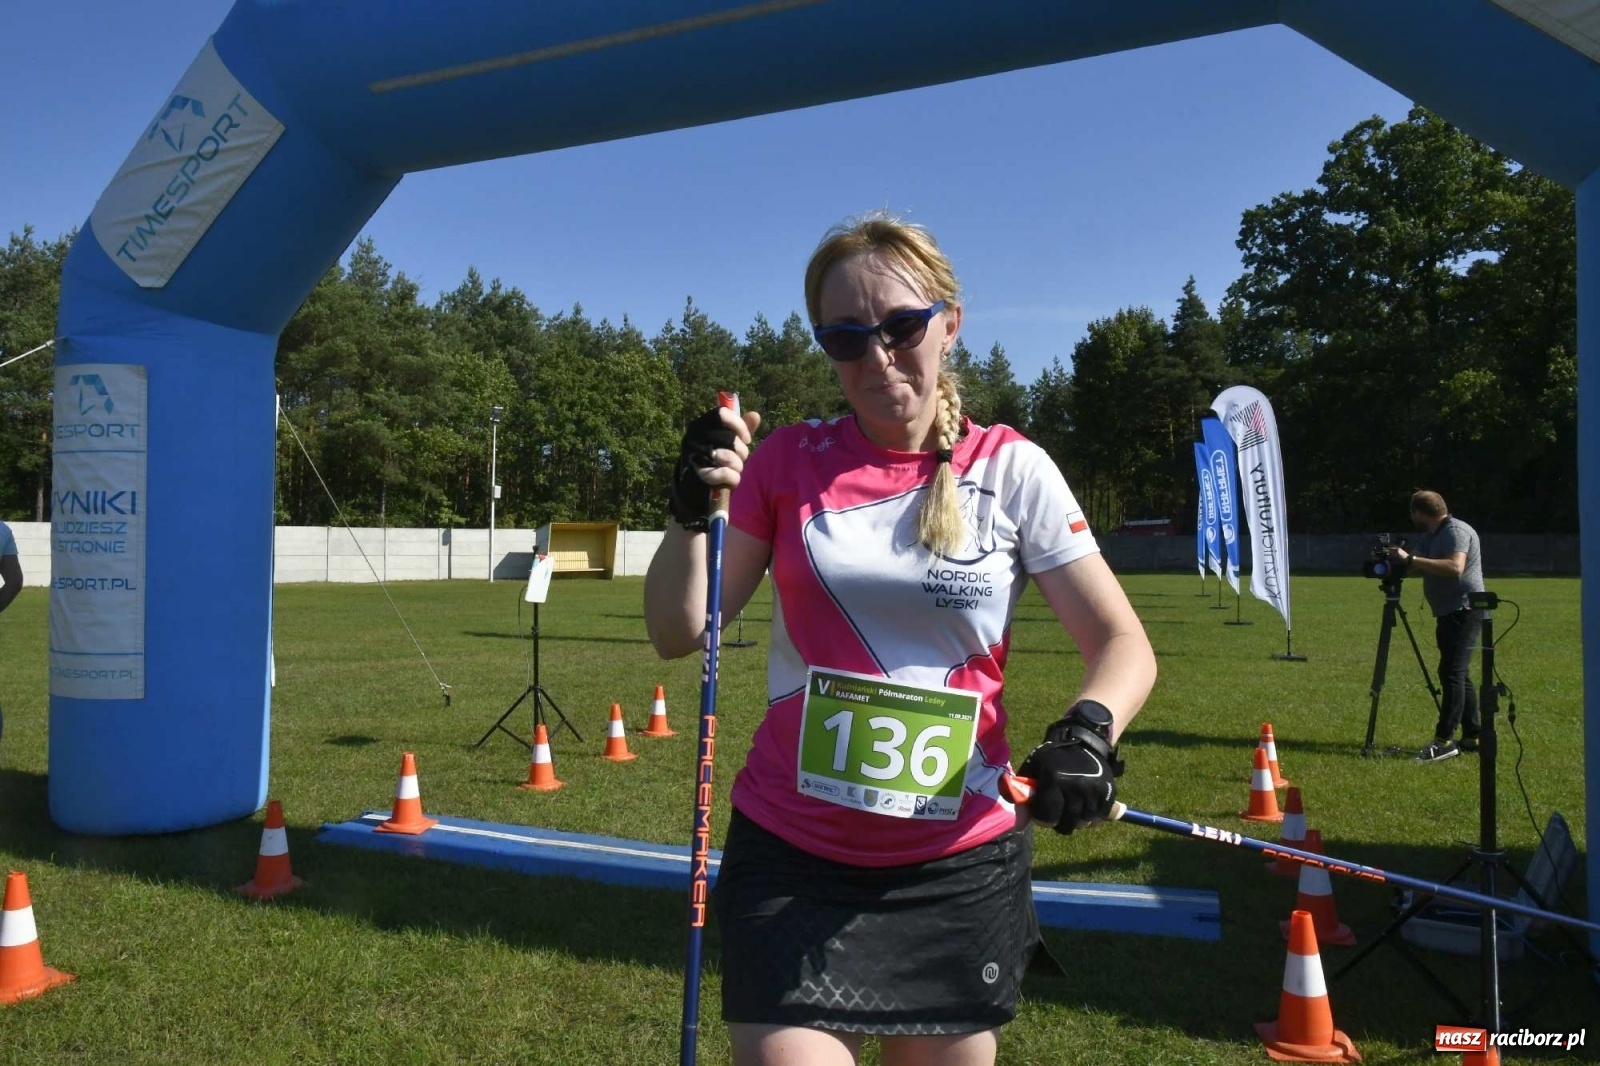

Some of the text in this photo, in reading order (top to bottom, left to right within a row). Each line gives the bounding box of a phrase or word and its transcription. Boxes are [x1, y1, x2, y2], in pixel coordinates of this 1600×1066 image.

[116, 93, 248, 262] TIMESPORT
[54, 423, 140, 439] ESPORT
[927, 568, 991, 583] NORDIC
[921, 581, 993, 597] WALKING
[935, 597, 979, 610] LYSKI
[835, 689, 871, 704] RAFAMET
[822, 709, 952, 788] 136
[691, 714, 716, 928] PACEMAKER
[1191, 823, 1242, 846] LEKI
